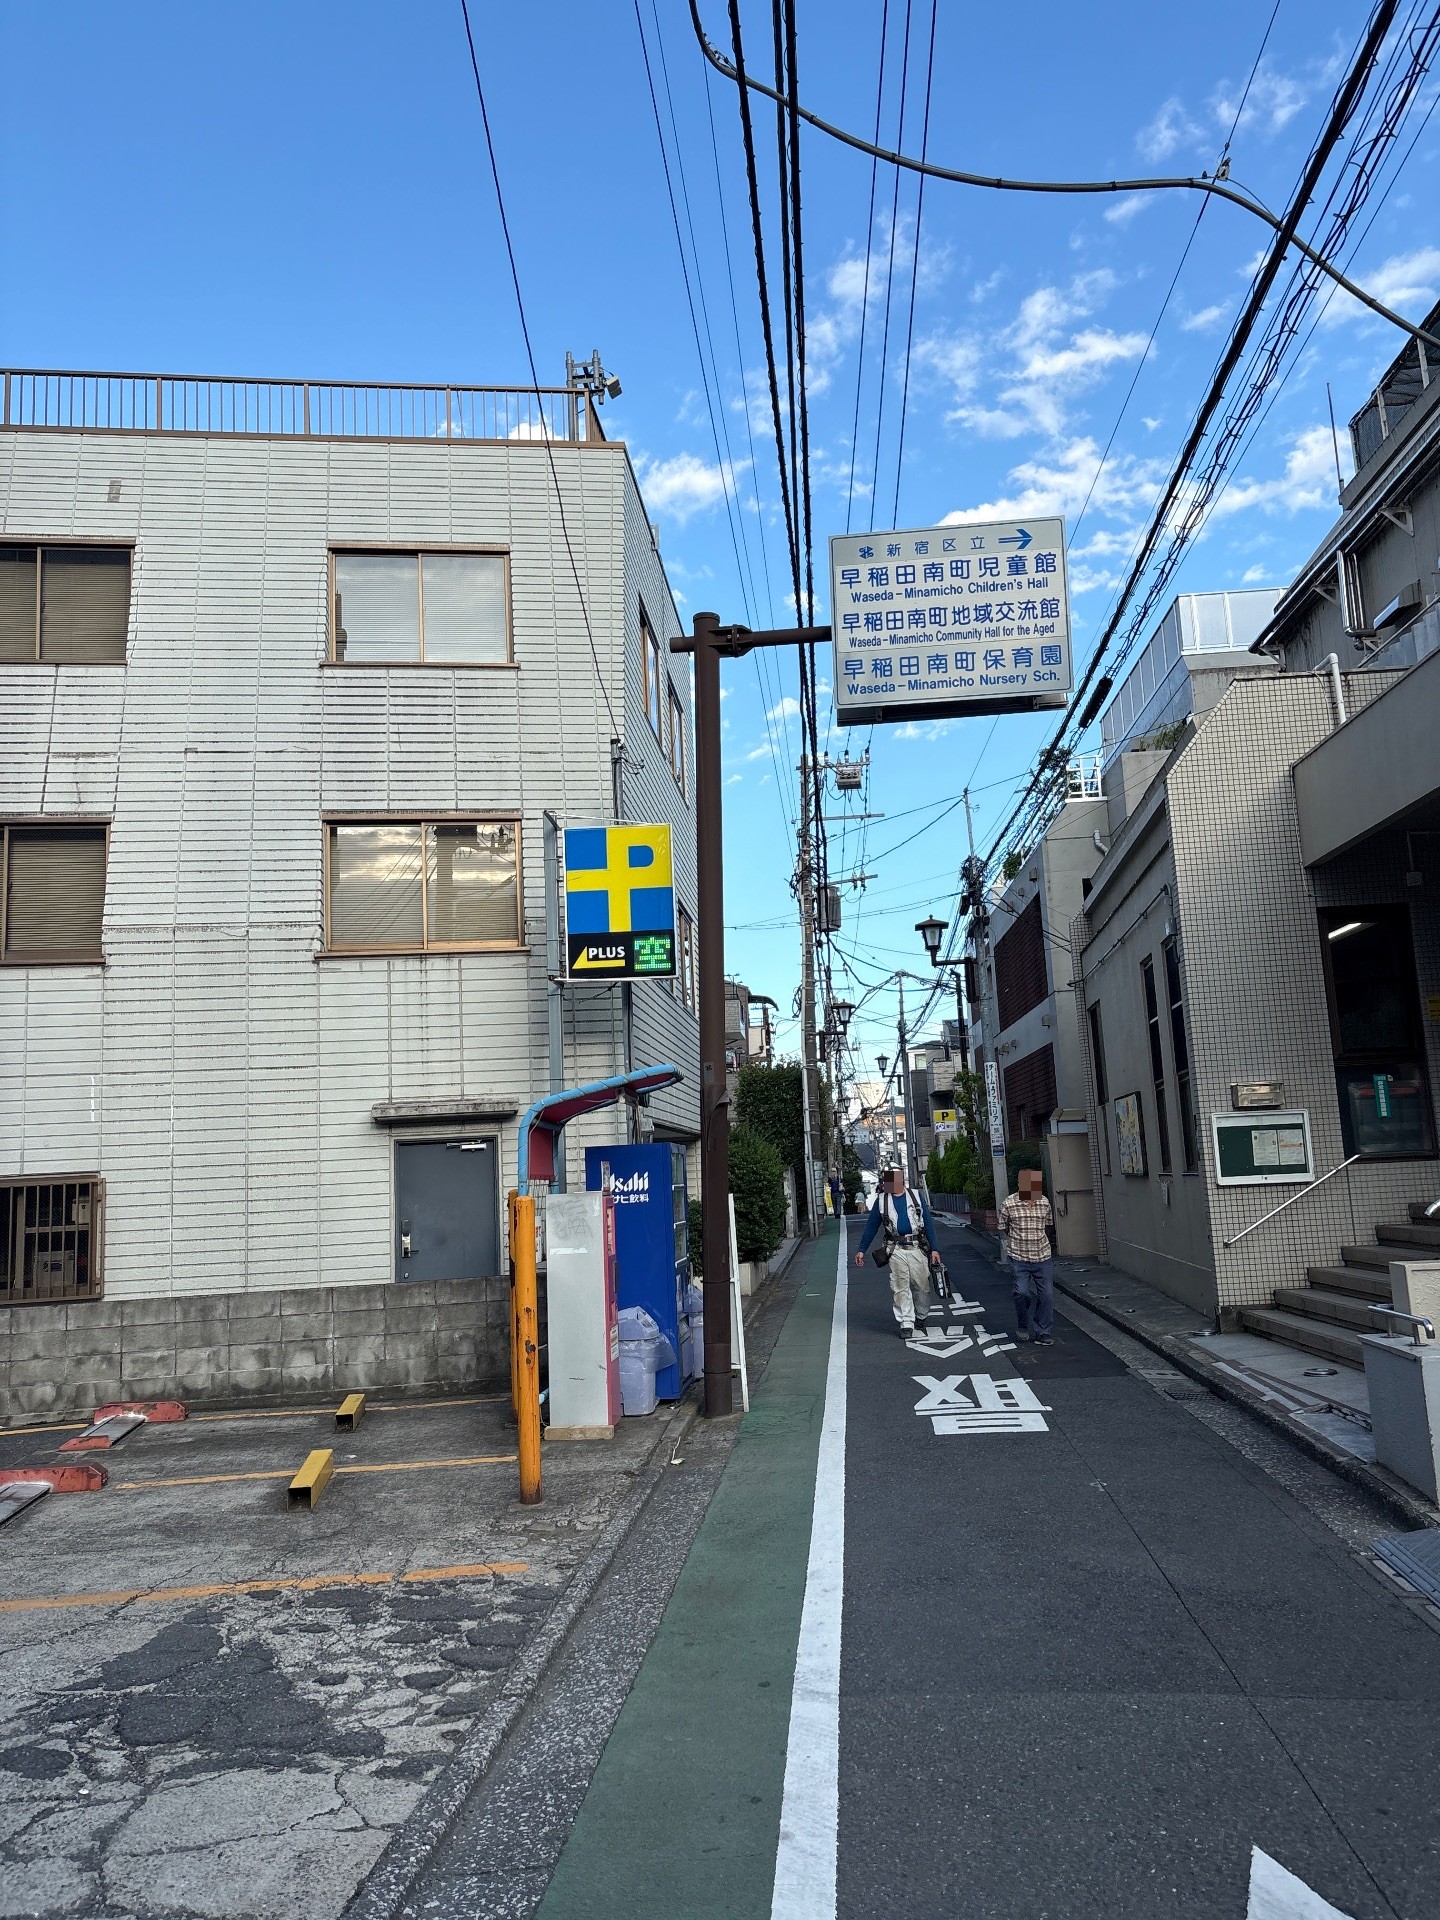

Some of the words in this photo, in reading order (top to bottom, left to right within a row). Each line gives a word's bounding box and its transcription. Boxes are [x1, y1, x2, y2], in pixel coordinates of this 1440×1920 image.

[886, 536, 985, 557] 新宿区立
[839, 552, 1057, 589] 早稲田南町児童館
[968, 578, 1023, 594] Children's
[1027, 577, 1049, 589] Hall
[841, 597, 1061, 634] 早稲田南町地域交流館
[936, 628, 982, 642] Community
[984, 626, 1001, 639] Hall
[1002, 625, 1015, 638] for
[1017, 624, 1031, 636] the
[1033, 622, 1055, 636] Aged
[842, 644, 1062, 680] 早稲田南町保育園
[979, 673, 1027, 686] Nursery
[1033, 669, 1061, 682] Sch.
[588, 946, 625, 959] PLUS
[634, 936, 671, 969] 空
[942, 1112, 949, 1121] P
[612, 1193, 649, 1204] サヒ飲料
